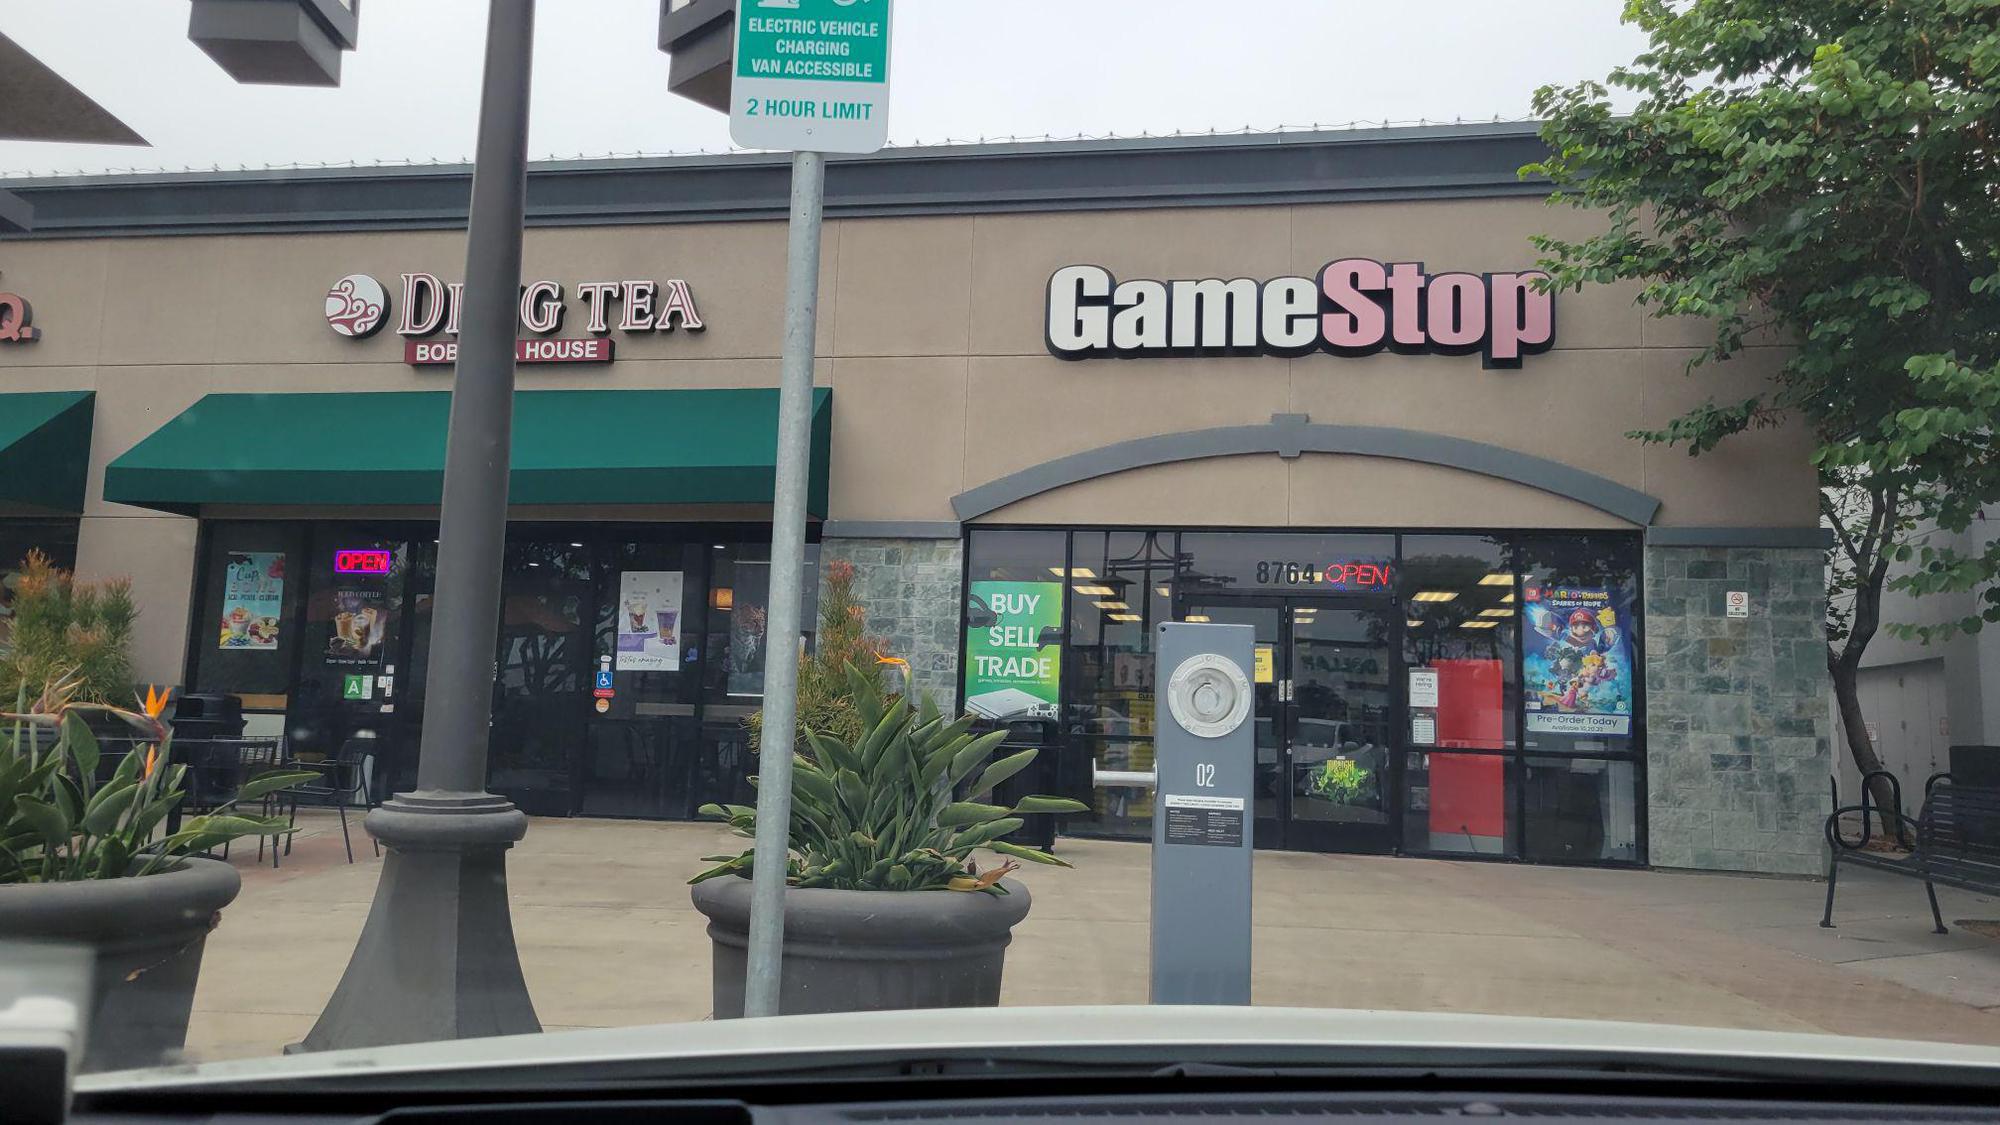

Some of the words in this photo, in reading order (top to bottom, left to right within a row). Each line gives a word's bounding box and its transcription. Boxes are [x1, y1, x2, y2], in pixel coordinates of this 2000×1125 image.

[748, 17, 816, 35] ELECTRIC
[820, 20, 879, 37] VEHICLE
[775, 39, 850, 57] CHARGING
[752, 58, 781, 74] VAN
[784, 61, 873, 78] ACCESSIBLE
[746, 98, 759, 116] 2
[765, 99, 816, 118] HOUR
[822, 101, 874, 121] LIMIT
[397, 272, 564, 335] DIG
[576, 279, 705, 334] TEA
[1046, 258, 1555, 364] GameStop
[416, 344, 458, 361] BOB
[525, 340, 599, 359] HOUSE
[337, 552, 388, 571] OPEN
[1256, 561, 1315, 584] 8764
[1325, 563, 1391, 586] OPEN
[991, 593, 1041, 615] BUY
[988, 626, 1040, 648] SELL
[974, 655, 1052, 679] TRADE
[347, 680, 360, 694] A
[1537, 714, 1585, 725] Pre-Order
[1588, 716, 1618, 728] Today
[1196, 763, 1216, 788] 02
